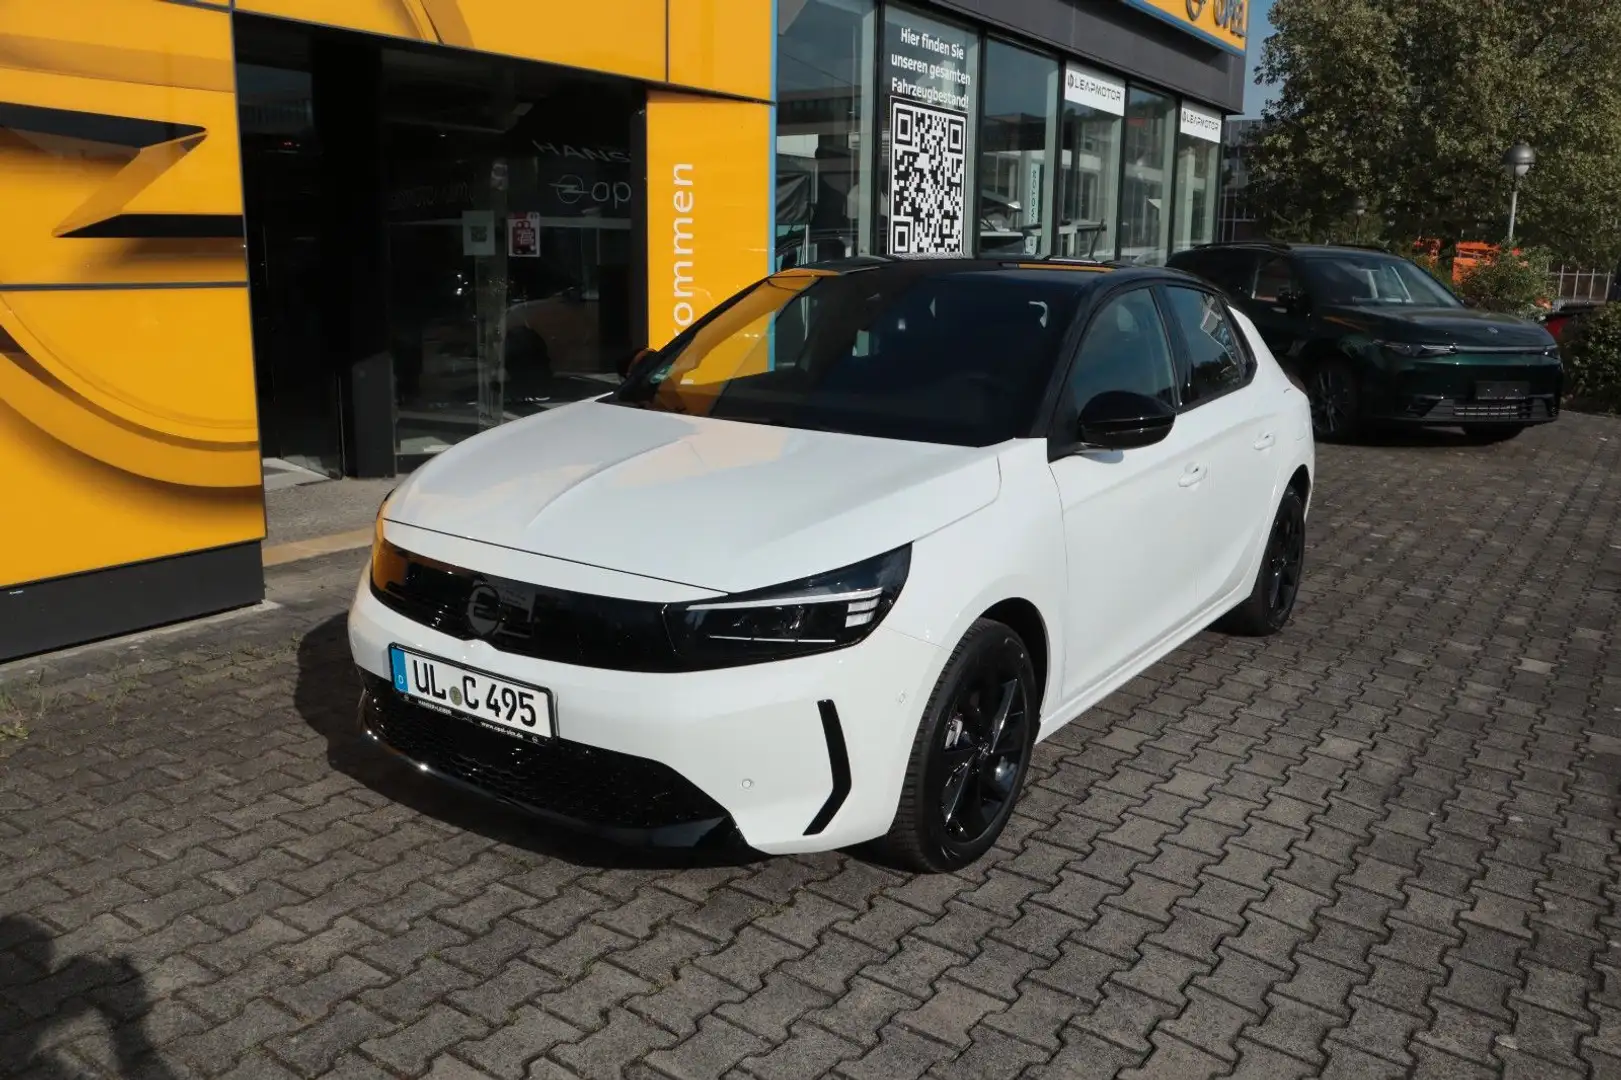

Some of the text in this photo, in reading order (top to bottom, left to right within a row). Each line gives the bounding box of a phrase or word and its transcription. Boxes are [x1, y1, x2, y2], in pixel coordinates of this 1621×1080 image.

[900, 27, 964, 60] Hier finden Sie
[891, 53, 971, 86] unseren gesamten
[891, 77, 969, 109] Fahrzeugbestand!
[1073, 78, 1121, 101] LEAPMOTOR
[1186, 112, 1219, 131] LEAPMOTOR
[398, 674, 405, 685] D
[413, 659, 537, 728] UL C 495
